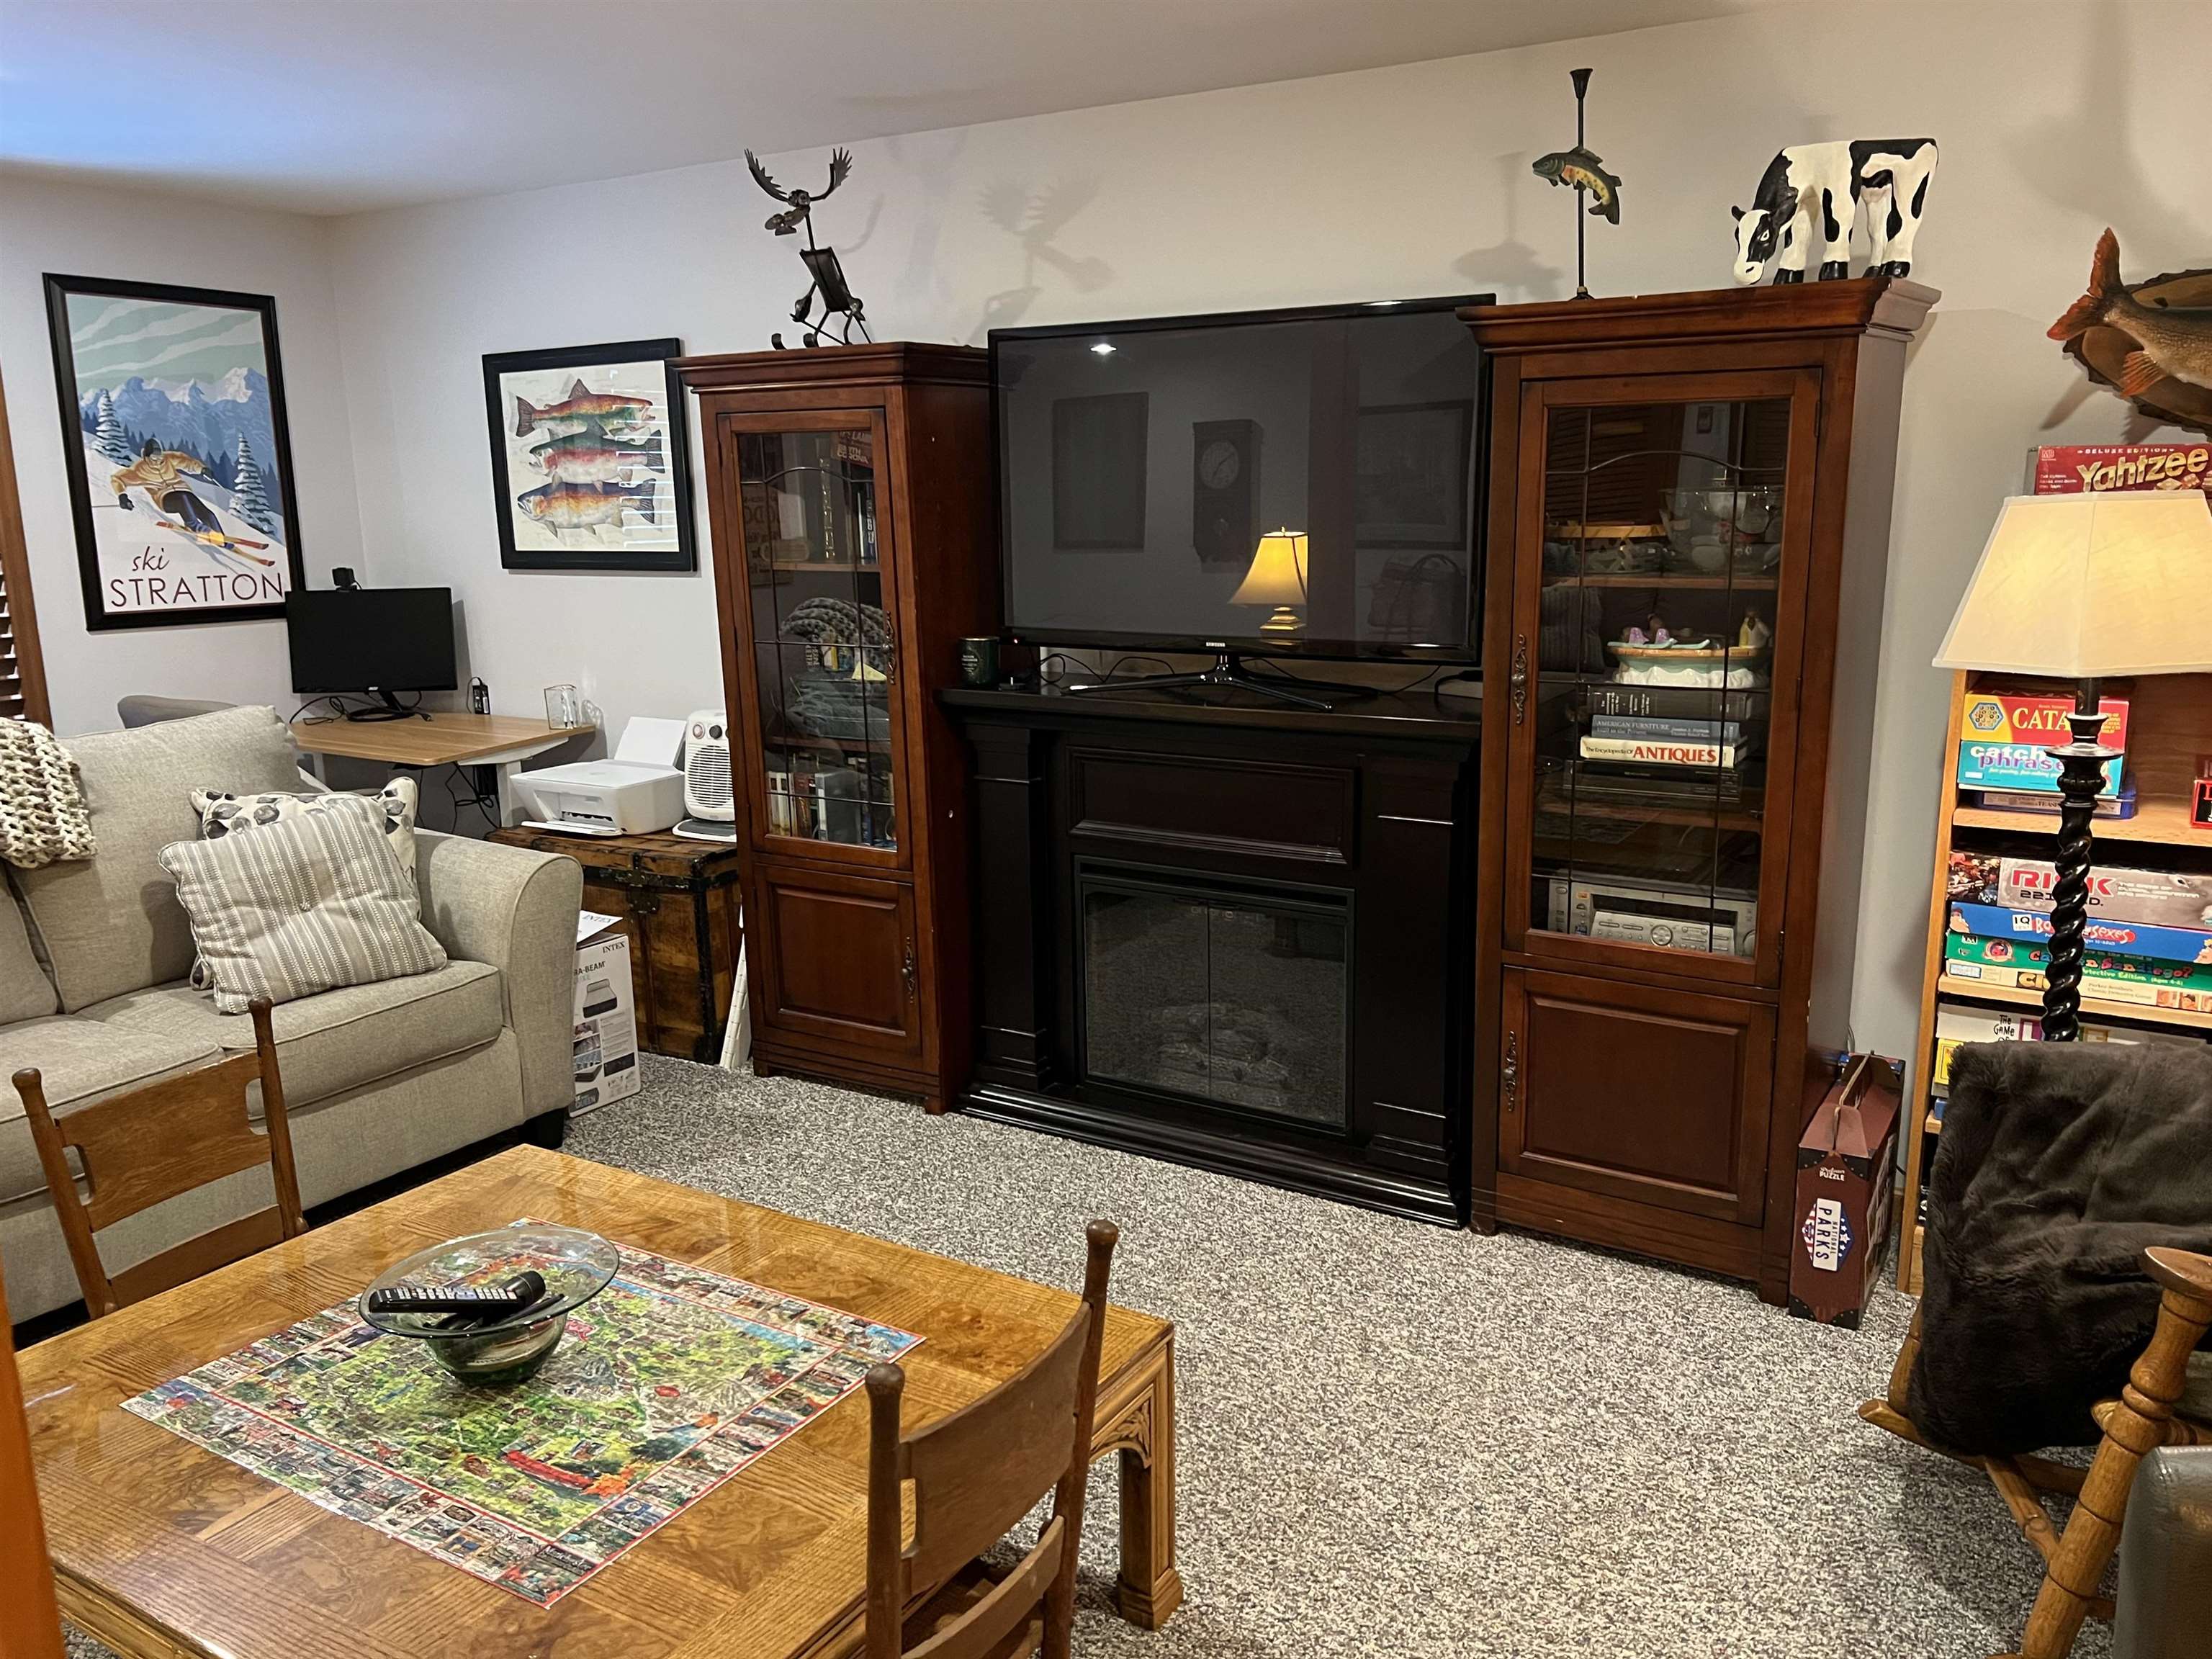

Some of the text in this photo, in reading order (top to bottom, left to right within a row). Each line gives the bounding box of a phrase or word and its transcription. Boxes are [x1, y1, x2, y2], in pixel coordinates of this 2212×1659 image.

[2076, 448, 2209, 493] Yahtzee
[132, 546, 170, 572] ski
[110, 572, 284, 607] STRATTON
[1632, 722, 1671, 731] FURNITURE
[2012, 707, 2071, 732] CATA
[1632, 746, 1717, 764] ANTIQUES
[1970, 745, 2047, 761] catch
[2011, 868, 2116, 897] RIK
[603, 941, 625, 953] INTEX
[575, 961, 606, 976] RA-BEAM
[2082, 967, 2116, 977] etective
[2118, 972, 2146, 981] Edition
[1820, 1170, 1845, 1182] PUZZLE
[1815, 1207, 1833, 1259] PARKS
